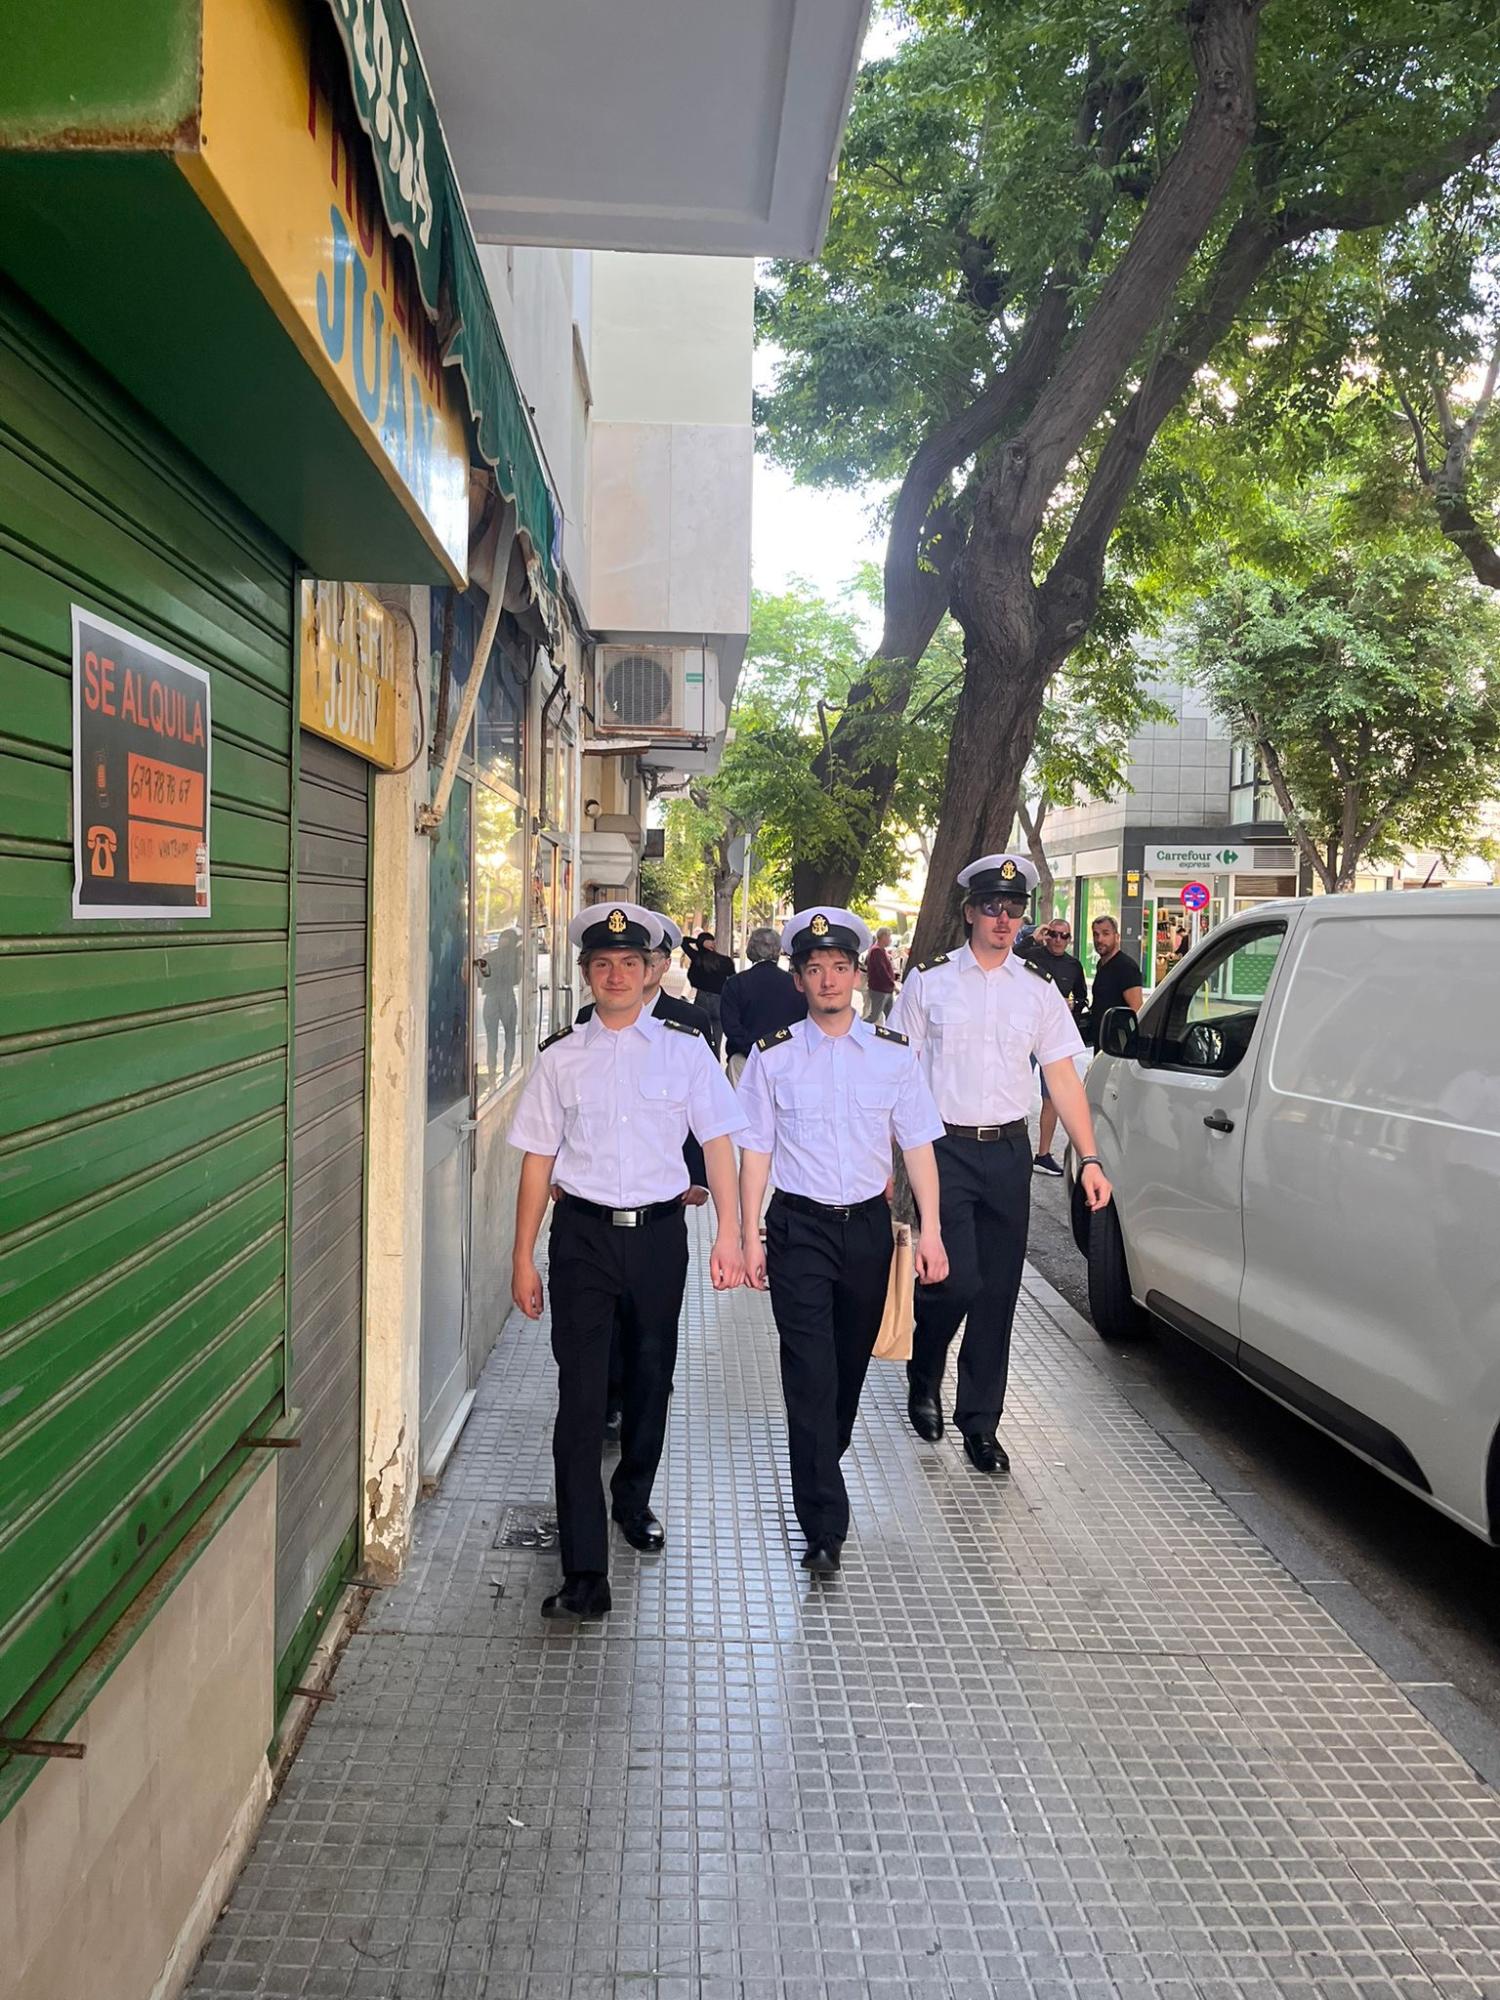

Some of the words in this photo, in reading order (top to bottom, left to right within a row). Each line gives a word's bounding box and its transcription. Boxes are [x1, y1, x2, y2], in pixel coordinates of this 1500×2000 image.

[316, 203, 436, 500] JUAN
[84, 651, 116, 716] SE
[121, 668, 204, 747] ALQUILA
[324, 652, 375, 745] JUAN
[1156, 850, 1212, 861] Carrefour
